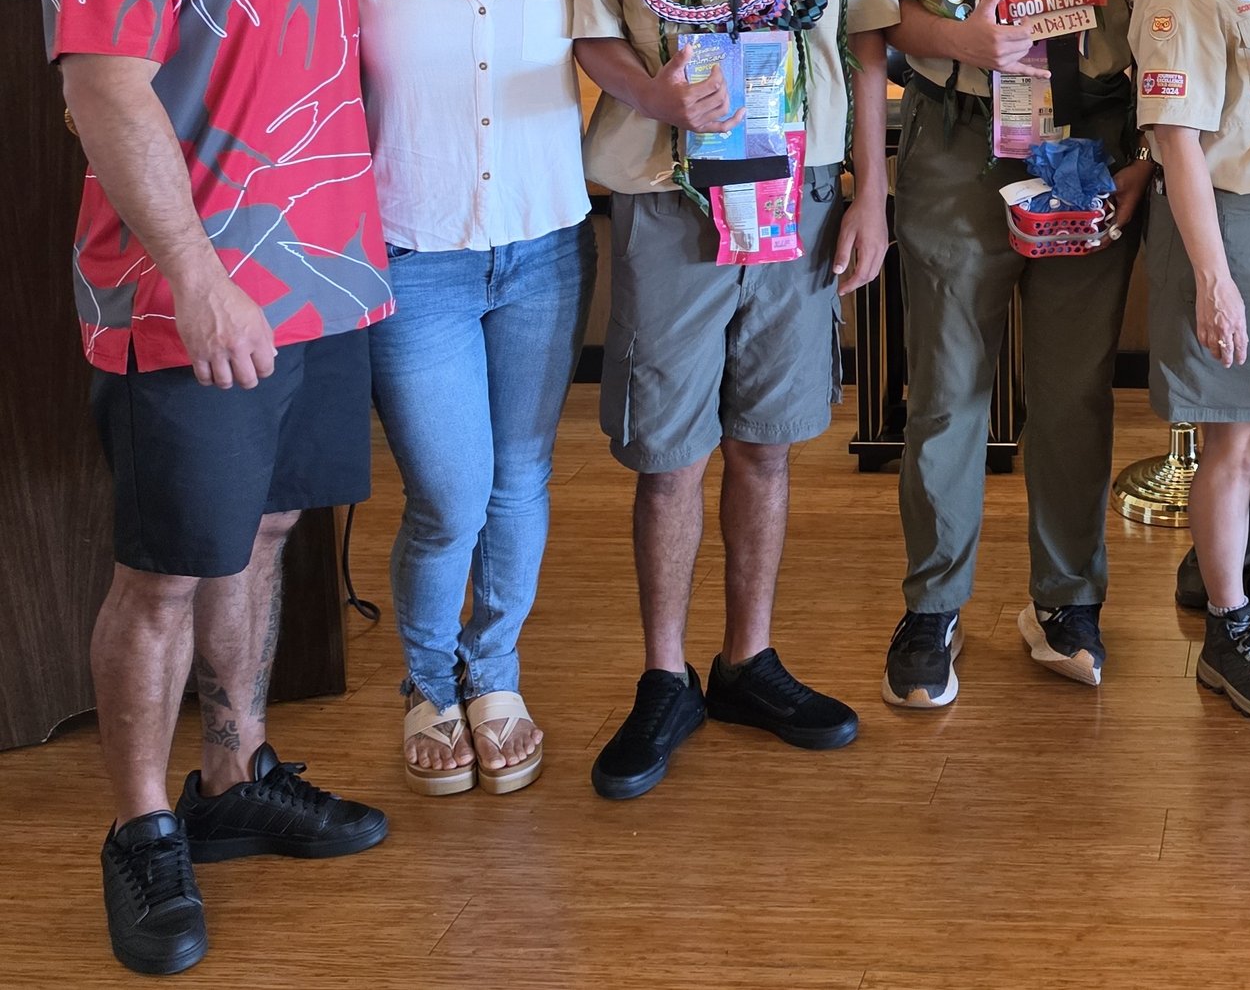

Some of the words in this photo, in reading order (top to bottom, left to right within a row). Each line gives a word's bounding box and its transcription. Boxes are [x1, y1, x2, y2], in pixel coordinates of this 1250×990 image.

[1044, 15, 1066, 33] Did
[1066, 10, 1091, 29] It!
[1161, 87, 1180, 95] 2024
